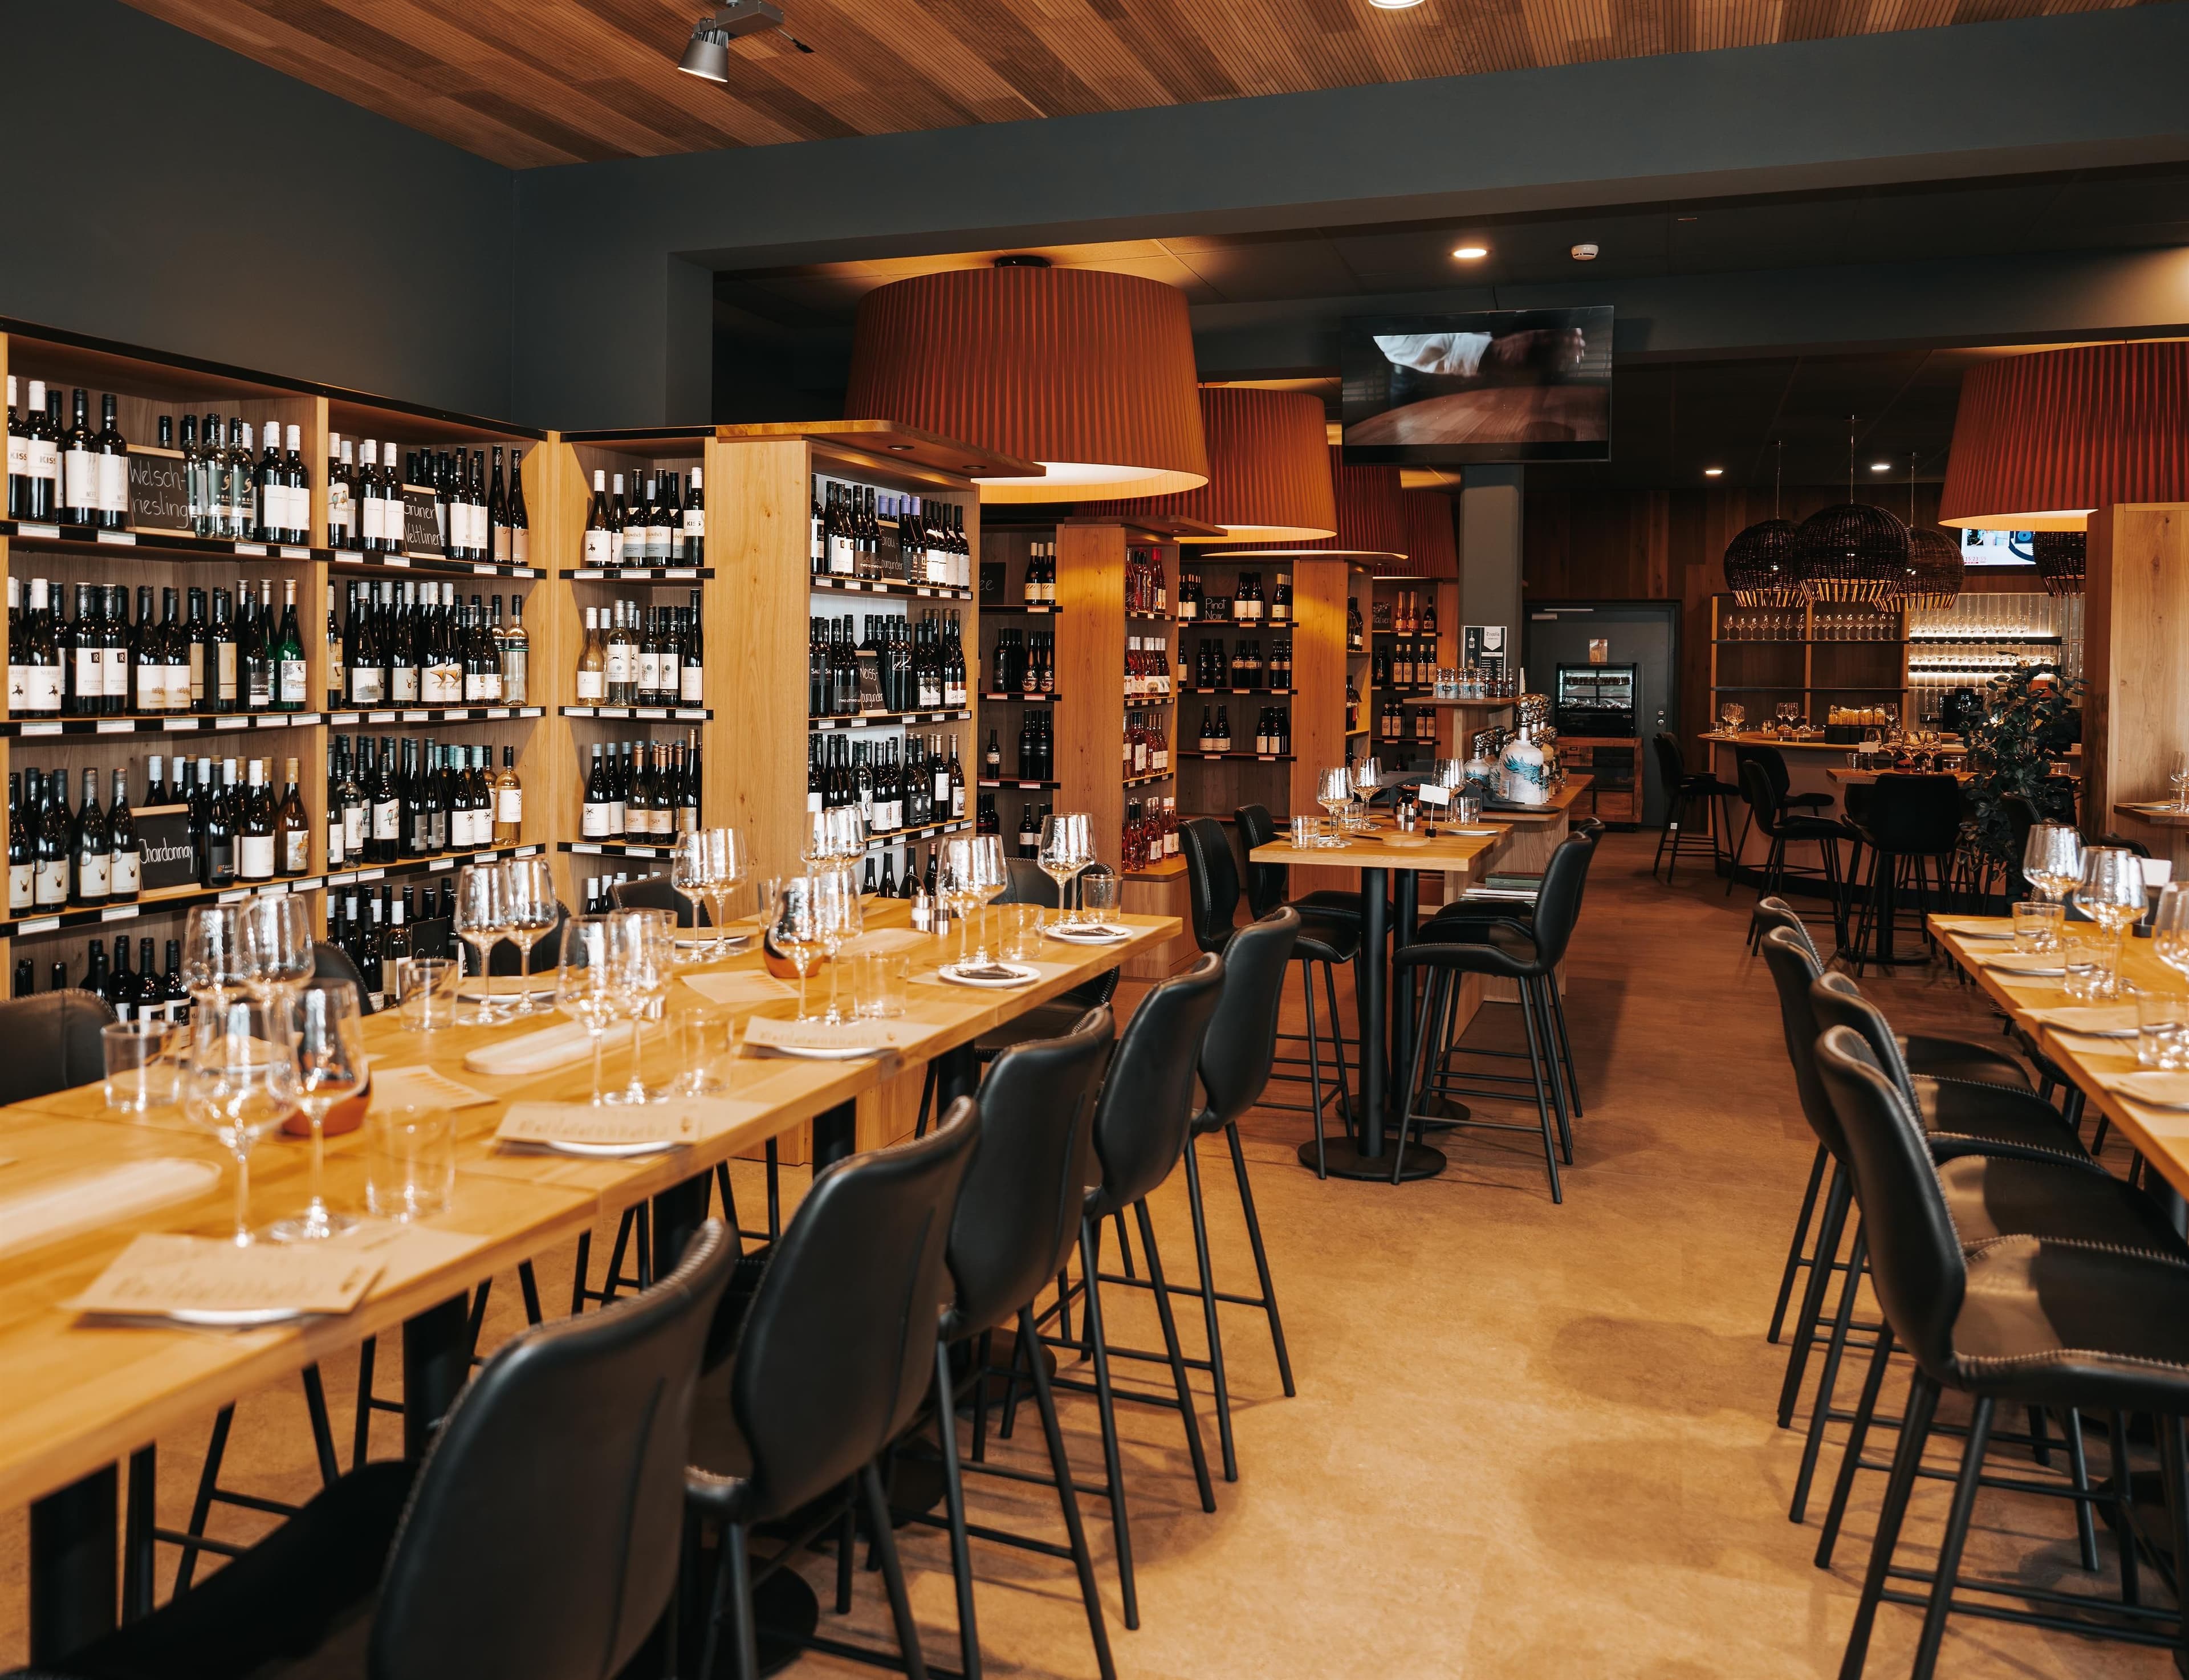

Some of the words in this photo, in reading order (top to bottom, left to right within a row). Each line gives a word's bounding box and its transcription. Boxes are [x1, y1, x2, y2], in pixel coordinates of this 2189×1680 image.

[128, 457, 186, 490] Welsch-
[132, 491, 189, 528] riesling
[404, 523, 442, 545] Veltliner
[1205, 597, 1227, 609] Pinot
[1205, 610, 1224, 620] Noir
[860, 684, 883, 707] burgunder
[138, 837, 193, 874] Chardonnay
